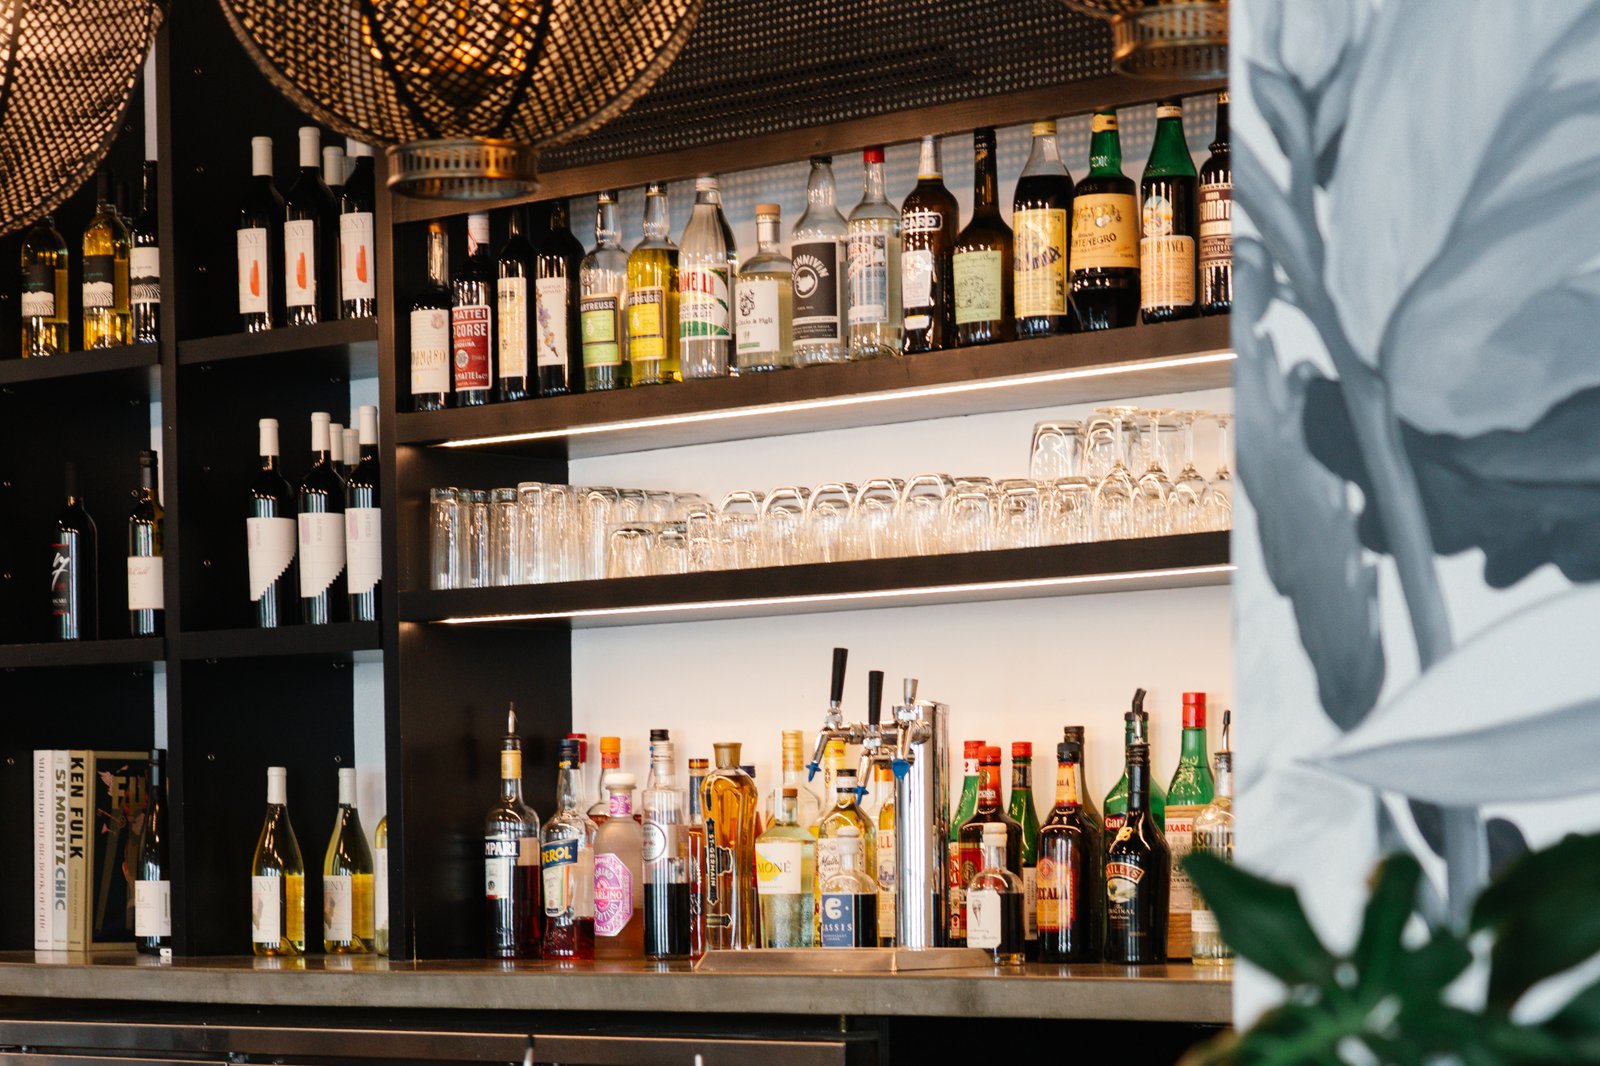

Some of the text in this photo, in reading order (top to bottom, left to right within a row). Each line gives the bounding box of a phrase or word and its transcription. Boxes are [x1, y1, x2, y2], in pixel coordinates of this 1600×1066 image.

[456, 323, 487, 338] CORSE
[71, 757, 84, 798] KEN
[55, 769, 66, 911] ST. MORITZ CHIC
[69, 807, 84, 860] FULK
